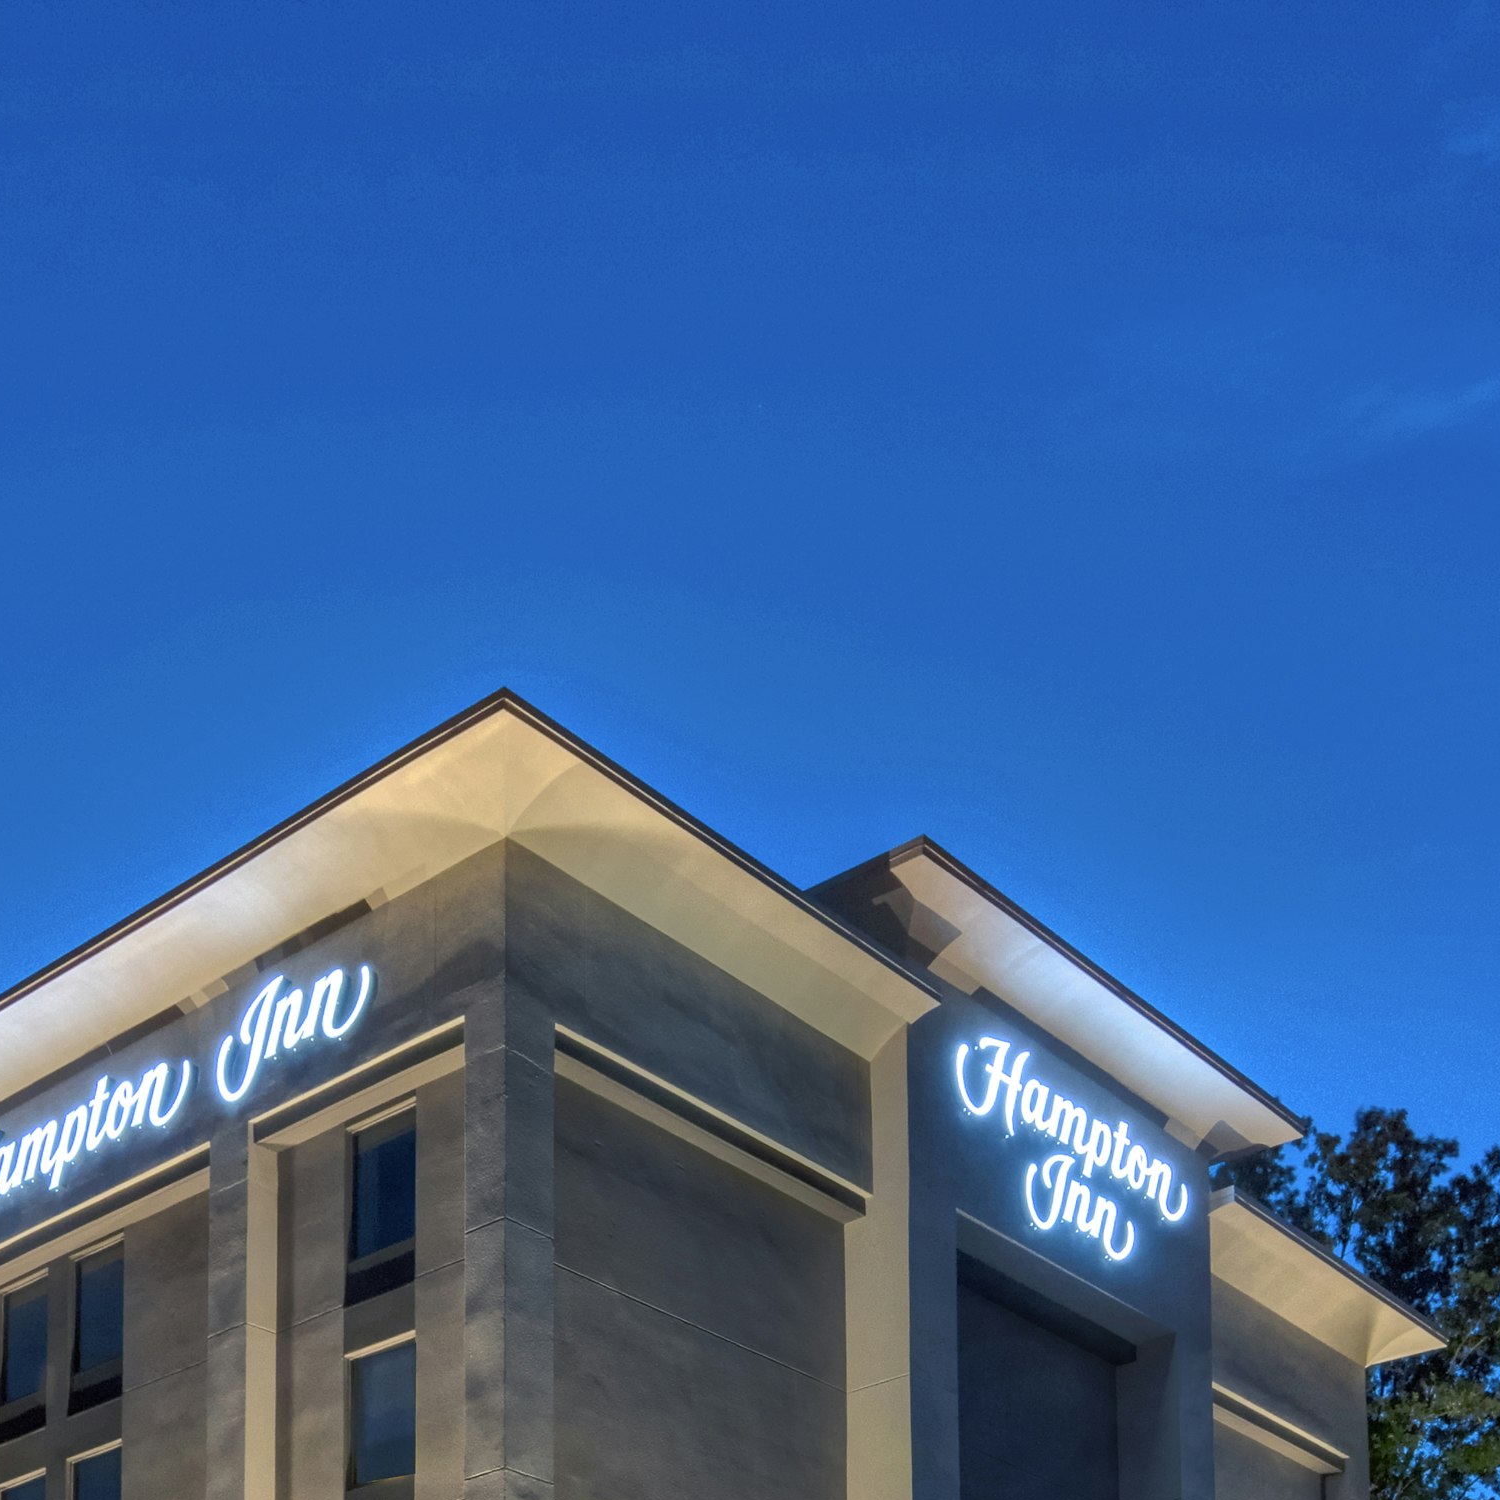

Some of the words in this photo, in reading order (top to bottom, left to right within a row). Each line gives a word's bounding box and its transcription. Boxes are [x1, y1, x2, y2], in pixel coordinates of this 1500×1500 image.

[216, 965, 370, 1102] Inn
[955, 1036, 1188, 1222] Hampton
[1025, 1154, 1135, 1261] Inn
